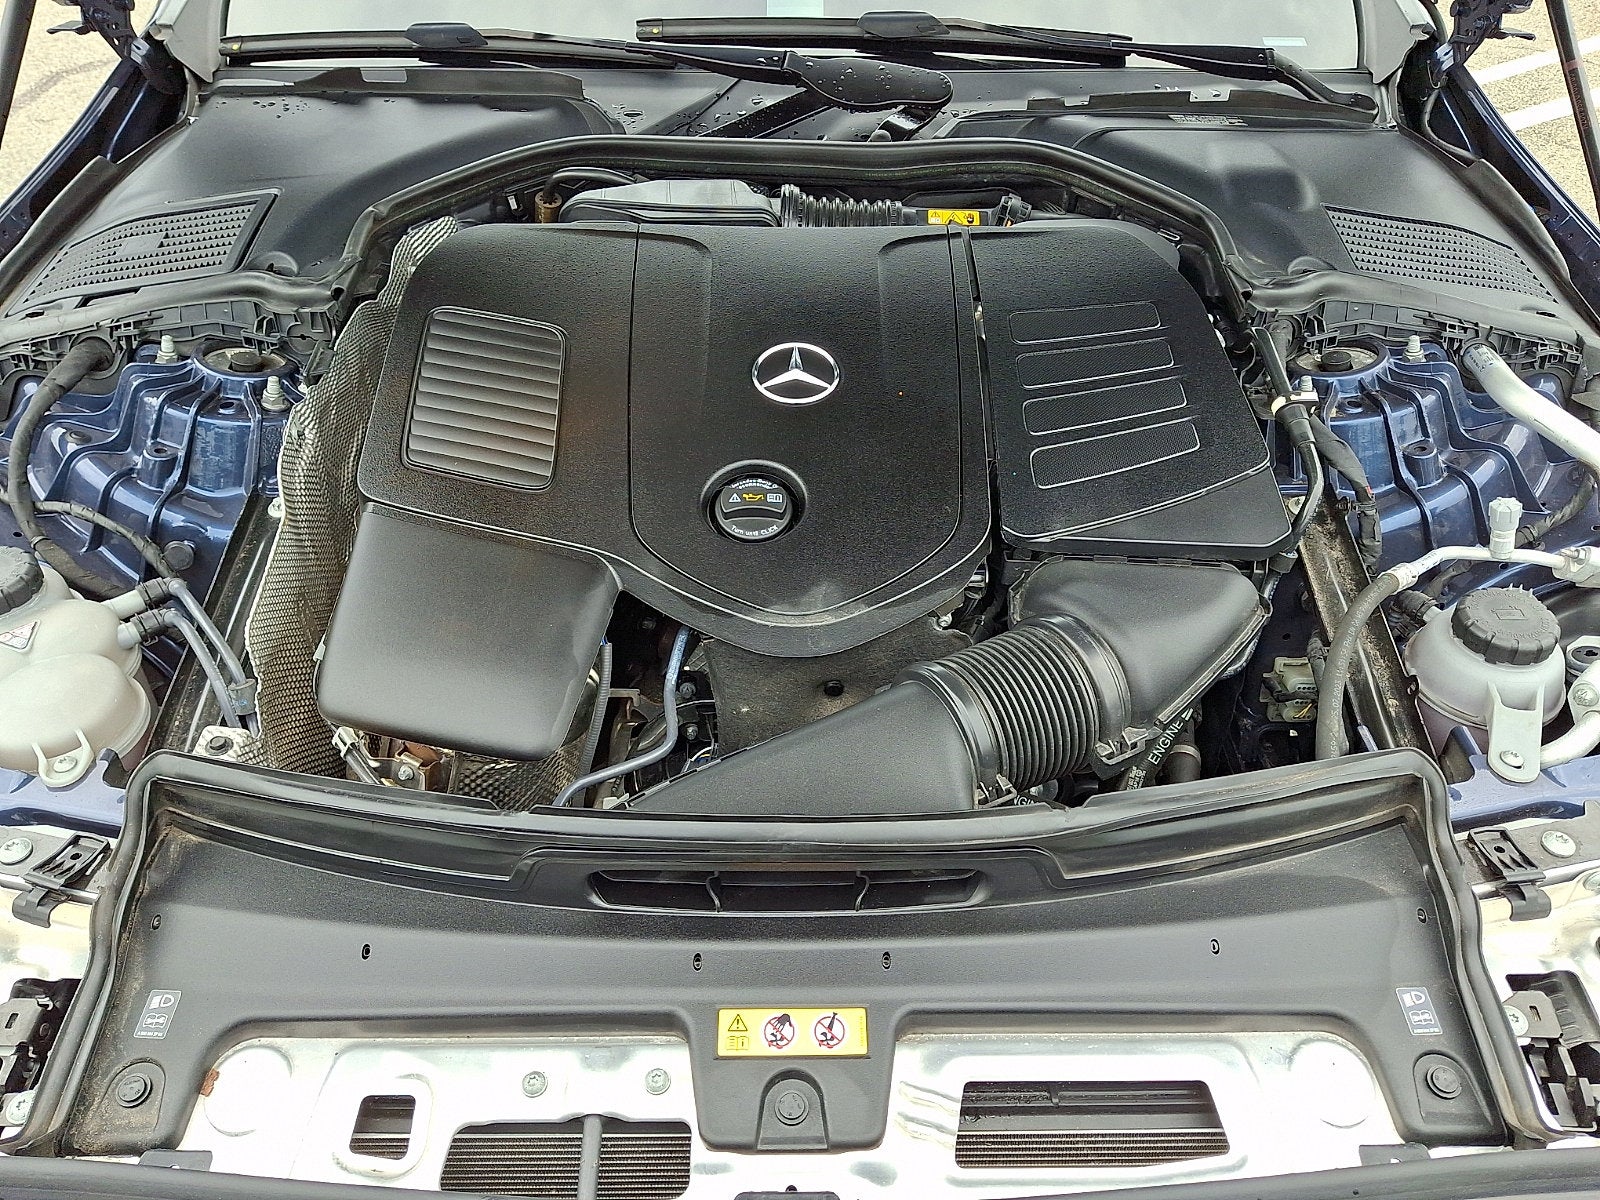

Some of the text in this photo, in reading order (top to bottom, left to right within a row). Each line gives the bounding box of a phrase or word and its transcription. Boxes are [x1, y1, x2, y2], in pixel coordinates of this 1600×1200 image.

[732, 525, 743, 534] Turn
[761, 525, 778, 535] CLICK
[1148, 721, 1184, 765] ENGINE
